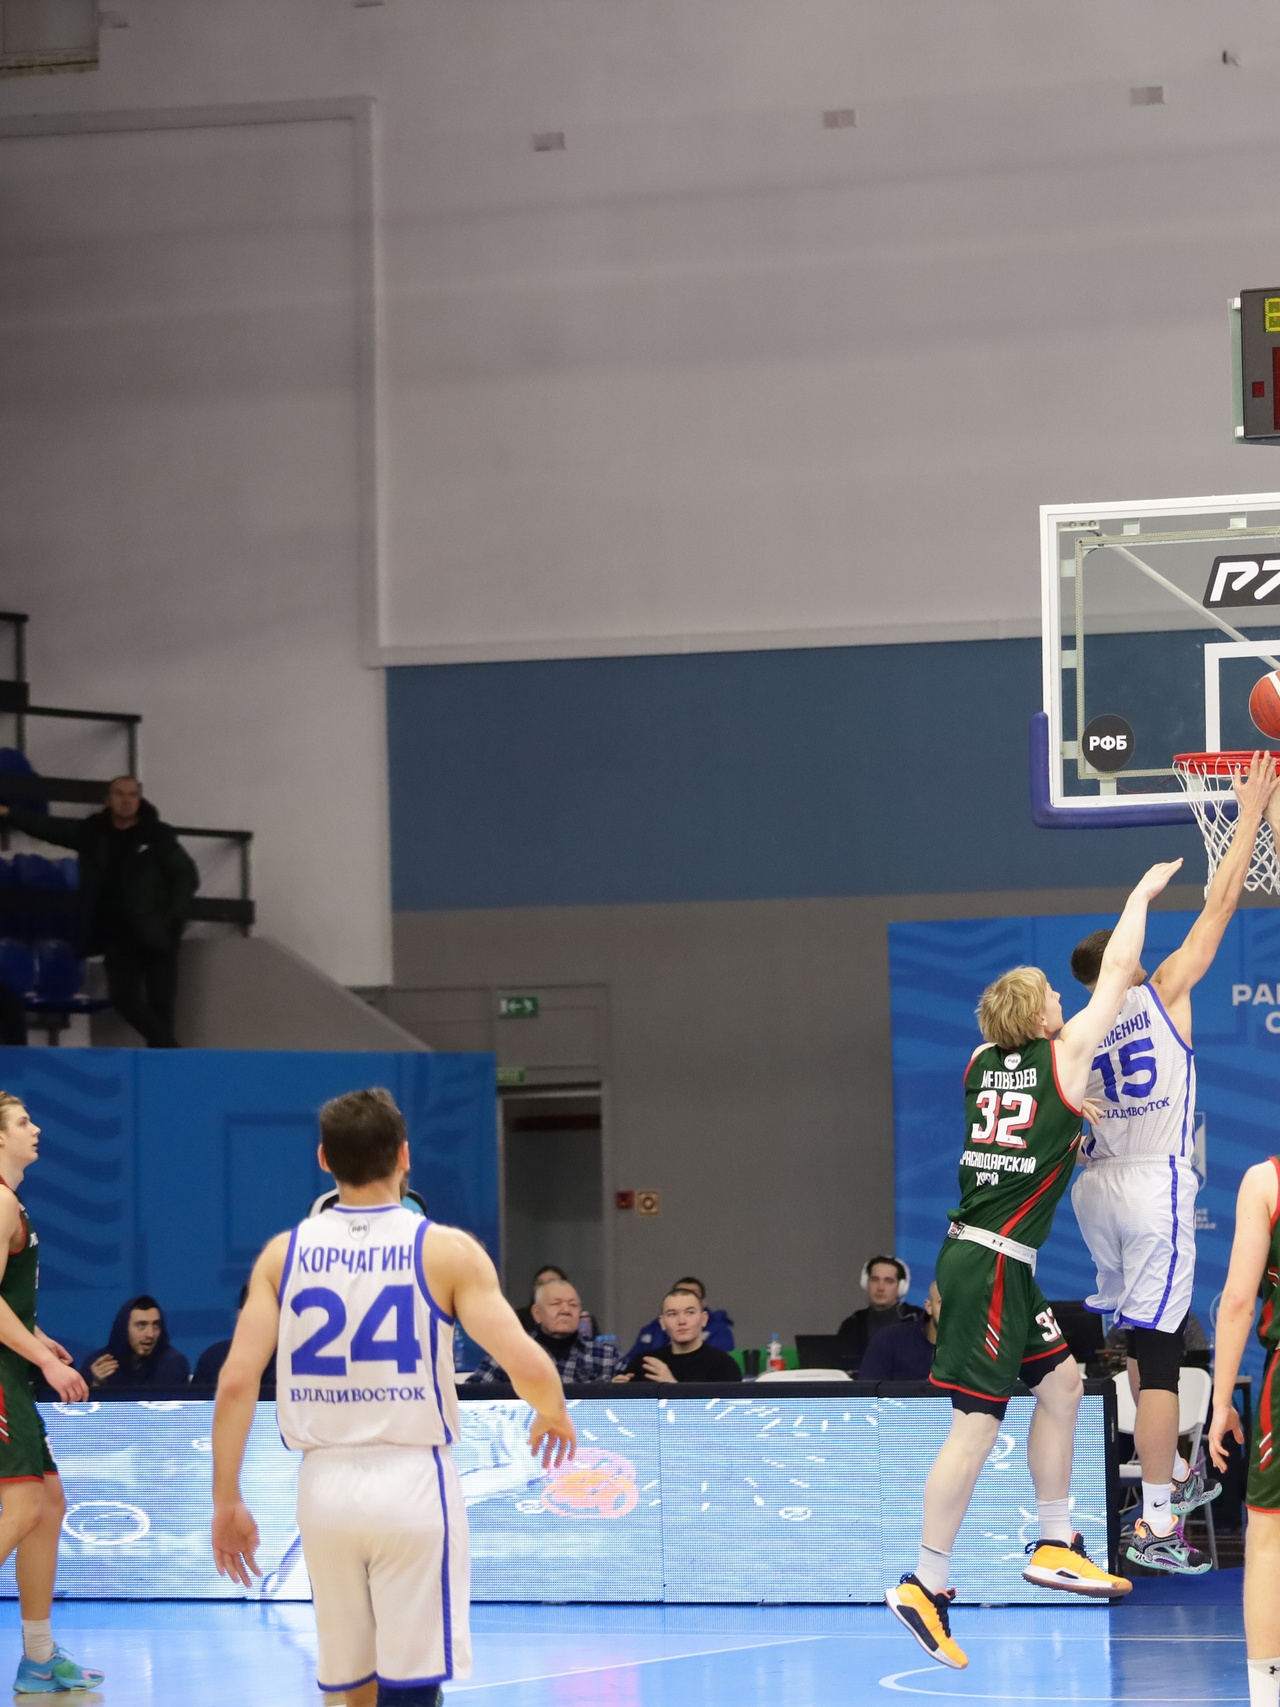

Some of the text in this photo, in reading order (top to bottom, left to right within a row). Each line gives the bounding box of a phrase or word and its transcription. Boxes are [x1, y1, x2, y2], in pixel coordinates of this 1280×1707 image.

[1089, 735, 1127, 751] РФБ
[981, 1068, 1038, 1090] МЕДВЕДЕВ
[1091, 1036, 1158, 1103] 15
[971, 1090, 1038, 1148] 32
[298, 1244, 413, 1274] КОРЧАГИН
[290, 1284, 423, 1376] 24
[290, 1387, 426, 1404] ВЛАДИВОСТОК
